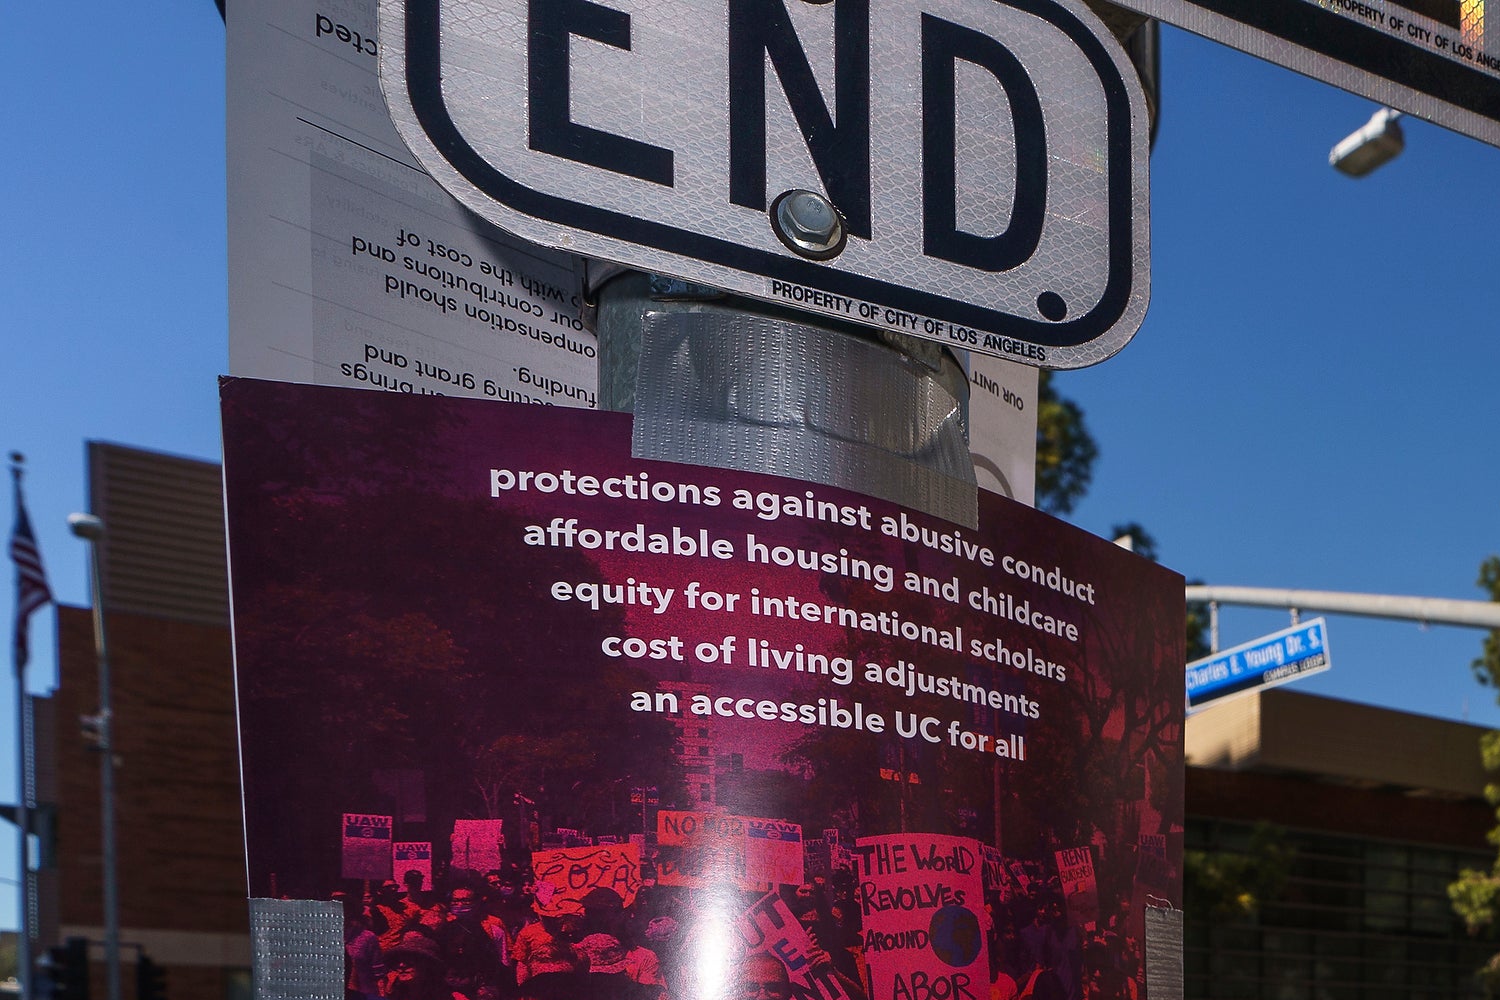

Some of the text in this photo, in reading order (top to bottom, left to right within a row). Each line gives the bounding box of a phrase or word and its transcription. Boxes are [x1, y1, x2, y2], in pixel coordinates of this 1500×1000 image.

[315, 13, 378, 58] cted
[1331, 0, 1385, 24] ROPERTY
[1389, 17, 1403, 30] OF
[1407, 24, 1431, 43] CITY
[1435, 35, 1450, 49] OF
[1453, 43, 1473, 60] LOS
[529, 0, 1047, 272] END
[352, 236, 395, 262] and
[396, 229, 420, 247] of
[428, 240, 472, 268] cost
[404, 256, 543, 321] contributions
[480, 261, 513, 286] the
[521, 278, 563, 307] with
[385, 275, 596, 358] ompensation should
[551, 312, 583, 332] our
[772, 280, 1045, 361] PROPERTY OF CITY OF LOS ANGELES
[364, 345, 554, 408] tting grant and
[512, 368, 597, 408] funding.
[970, 371, 1024, 411] OUR UNIT
[490, 466, 1096, 606] protections against abusive conduct
[523, 518, 1079, 642] affordable housing and childcare
[550, 577, 1066, 683] equity for international scholars
[1244, 642, 1284, 668] Young
[1285, 635, 1306, 656] Dr.
[600, 634, 1040, 720] cost of living adjustments
[630, 688, 1025, 761] an accessible UC for all
[347, 816, 389, 827] UAW
[664, 816, 697, 835] NO
[749, 821, 798, 832] UAW
[396, 844, 429, 852] UAW
[856, 843, 907, 876] THE
[1062, 848, 1090, 868] RENT
[861, 882, 966, 915] REVOLVES
[862, 929, 929, 952] AROUND
